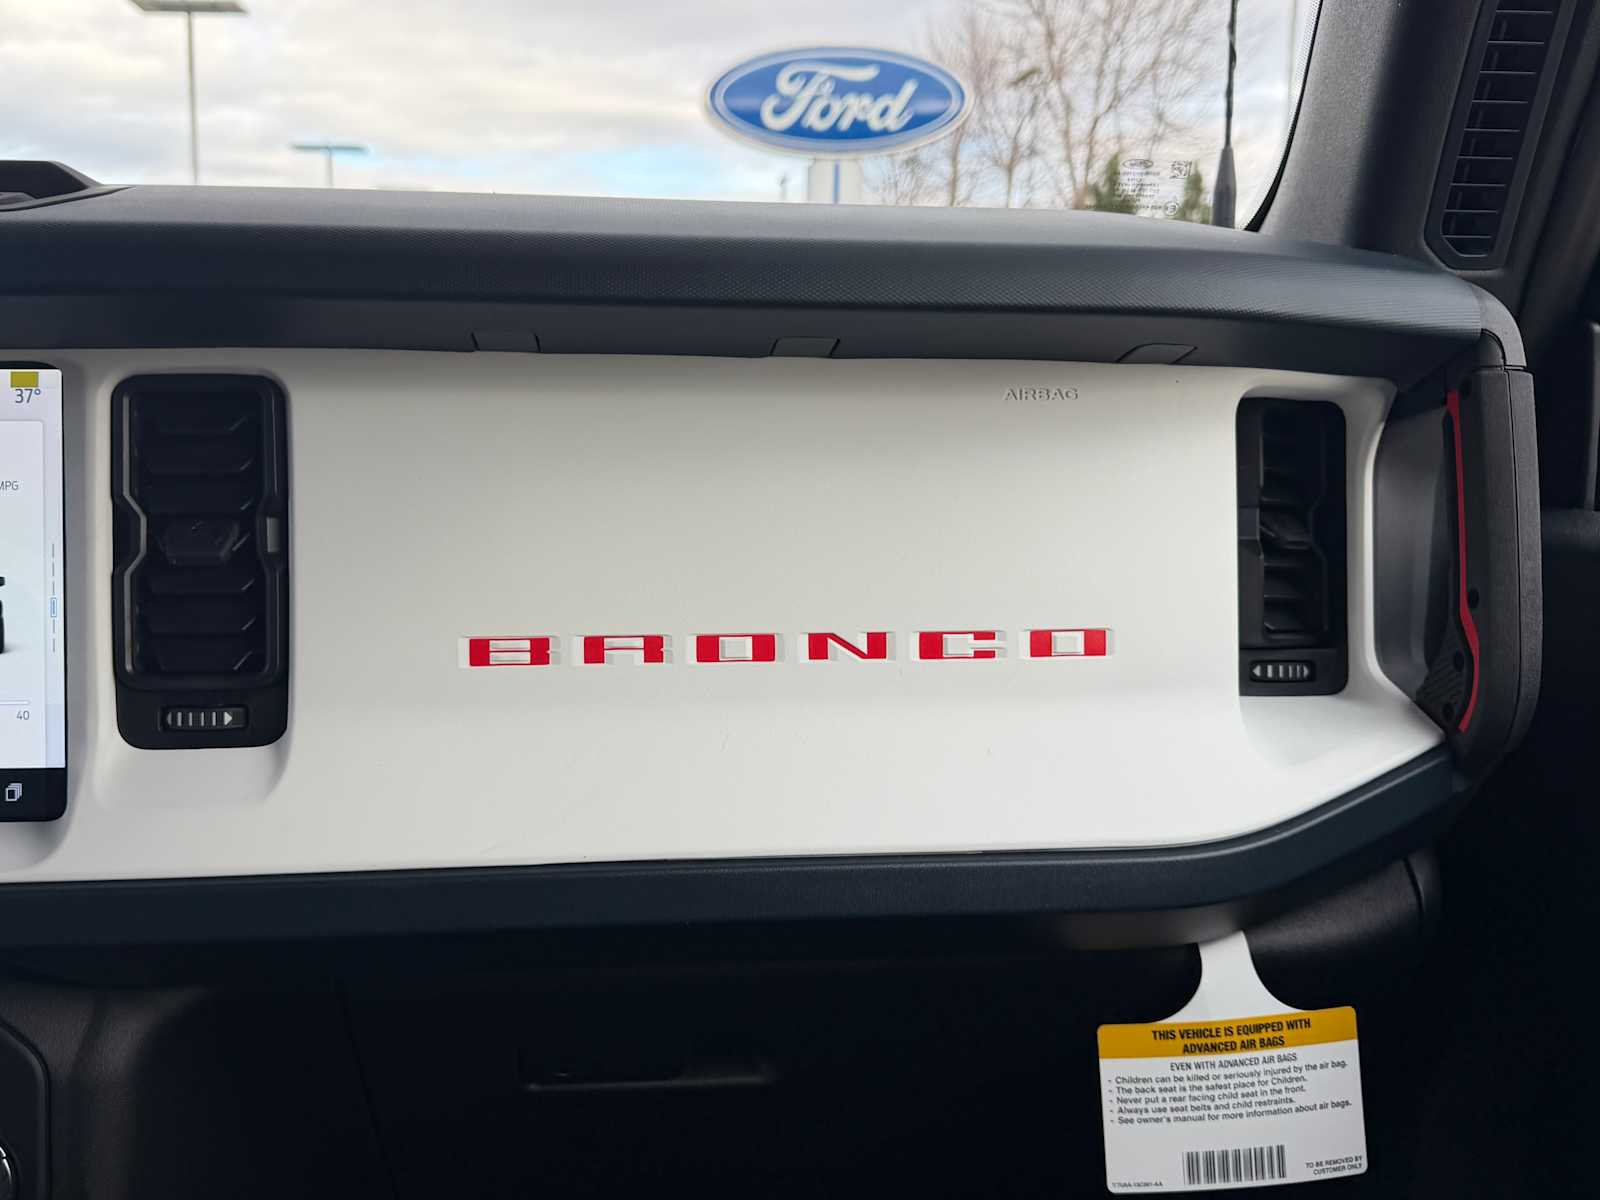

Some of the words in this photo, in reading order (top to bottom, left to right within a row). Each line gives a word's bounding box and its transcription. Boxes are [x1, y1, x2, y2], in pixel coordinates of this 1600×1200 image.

[760, 61, 918, 132] Ford
[16, 388, 41, 404] 37°
[1004, 388, 1079, 401] AIRBAG
[466, 627, 1108, 667] BRONCO
[16, 710, 30, 720] 40
[1152, 1030, 1176, 1040] THIS
[1179, 1028, 1220, 1040] VEHICLE
[1224, 1026, 1234, 1036] IS
[1237, 1022, 1284, 1035] EQUIPPED
[1286, 1018, 1311, 1030] WITH
[1183, 1040, 1236, 1054] ADVANCED
[1240, 1038, 1256, 1050] AIR
[1260, 1036, 1285, 1048] BAGS
[1170, 1062, 1192, 1071] EVEN
[1194, 1060, 1216, 1070] WITH
[1218, 1056, 1259, 1068] ADVANCED
[1262, 1054, 1275, 1064] AIR
[1277, 1052, 1297, 1062] BAGS
[1115, 1076, 1152, 1084] Children
[1187, 1074, 1209, 1082] killed
[1224, 1070, 1260, 1080] seriously
[1264, 1066, 1291, 1076] injured
[1331, 1060, 1348, 1068] bag.
[1205, 1082, 1230, 1090] safest
[1233, 1080, 1255, 1090] place
[1271, 1076, 1307, 1085] Children.
[1145, 1096, 1159, 1104] put
[1189, 1094, 1215, 1102] facing
[1218, 1092, 1238, 1100] child
[1285, 1085, 1306, 1094] front.
[1118, 1106, 1148, 1115] Always
[1190, 1103, 1211, 1112] belts
[1254, 1098, 1296, 1107] restraints.
[1174, 1114, 1205, 1122] manual
[1246, 1107, 1293, 1118] information
[1295, 1103, 1317, 1112] about
[1331, 1100, 1352, 1108] bags.
[1313, 1165, 1345, 1174] CUSTOMER
[1325, 1157, 1353, 1166] REMOVED
